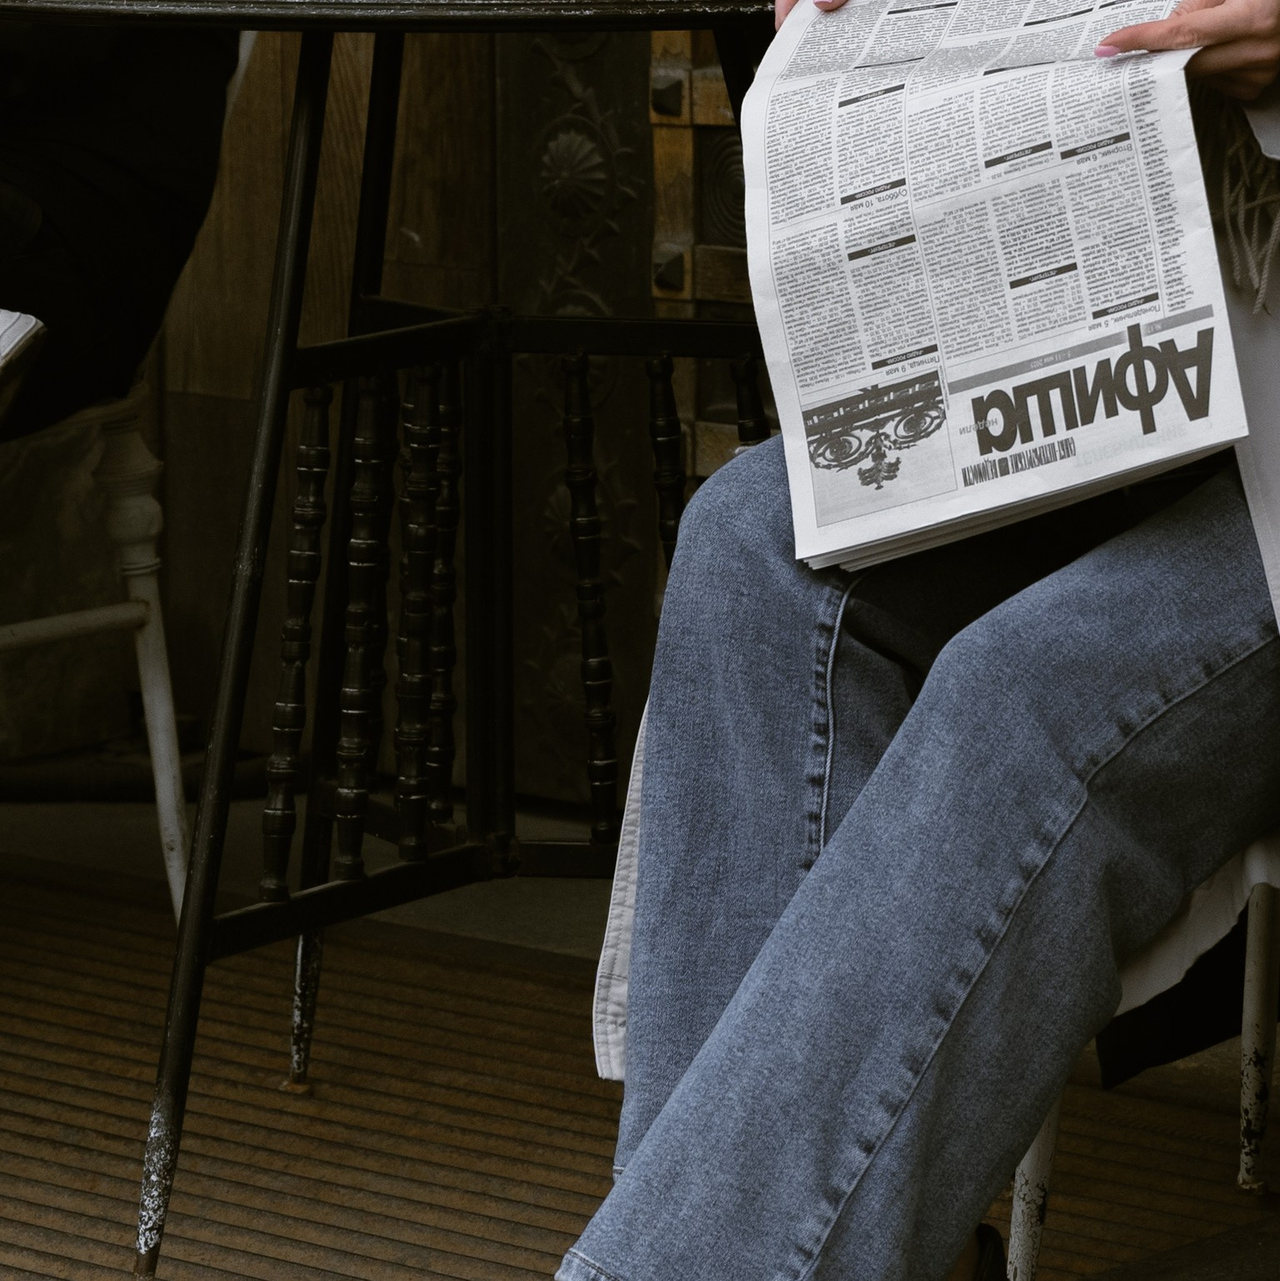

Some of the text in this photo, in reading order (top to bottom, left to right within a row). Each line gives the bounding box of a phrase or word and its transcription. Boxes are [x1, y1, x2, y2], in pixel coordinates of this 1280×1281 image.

[1075, 141, 1133, 165] Вторник, 6 мая
[849, 186, 908, 212] Суббота, 10 мая
[1087, 302, 1161, 331] Понедельник, 5 мая
[884, 352, 941, 376] Пятница, 9 мая
[971, 323, 1214, 456] Афиша
[959, 418, 998, 436] недели
[961, 458, 998, 487] ВЕДОМОСТИ
